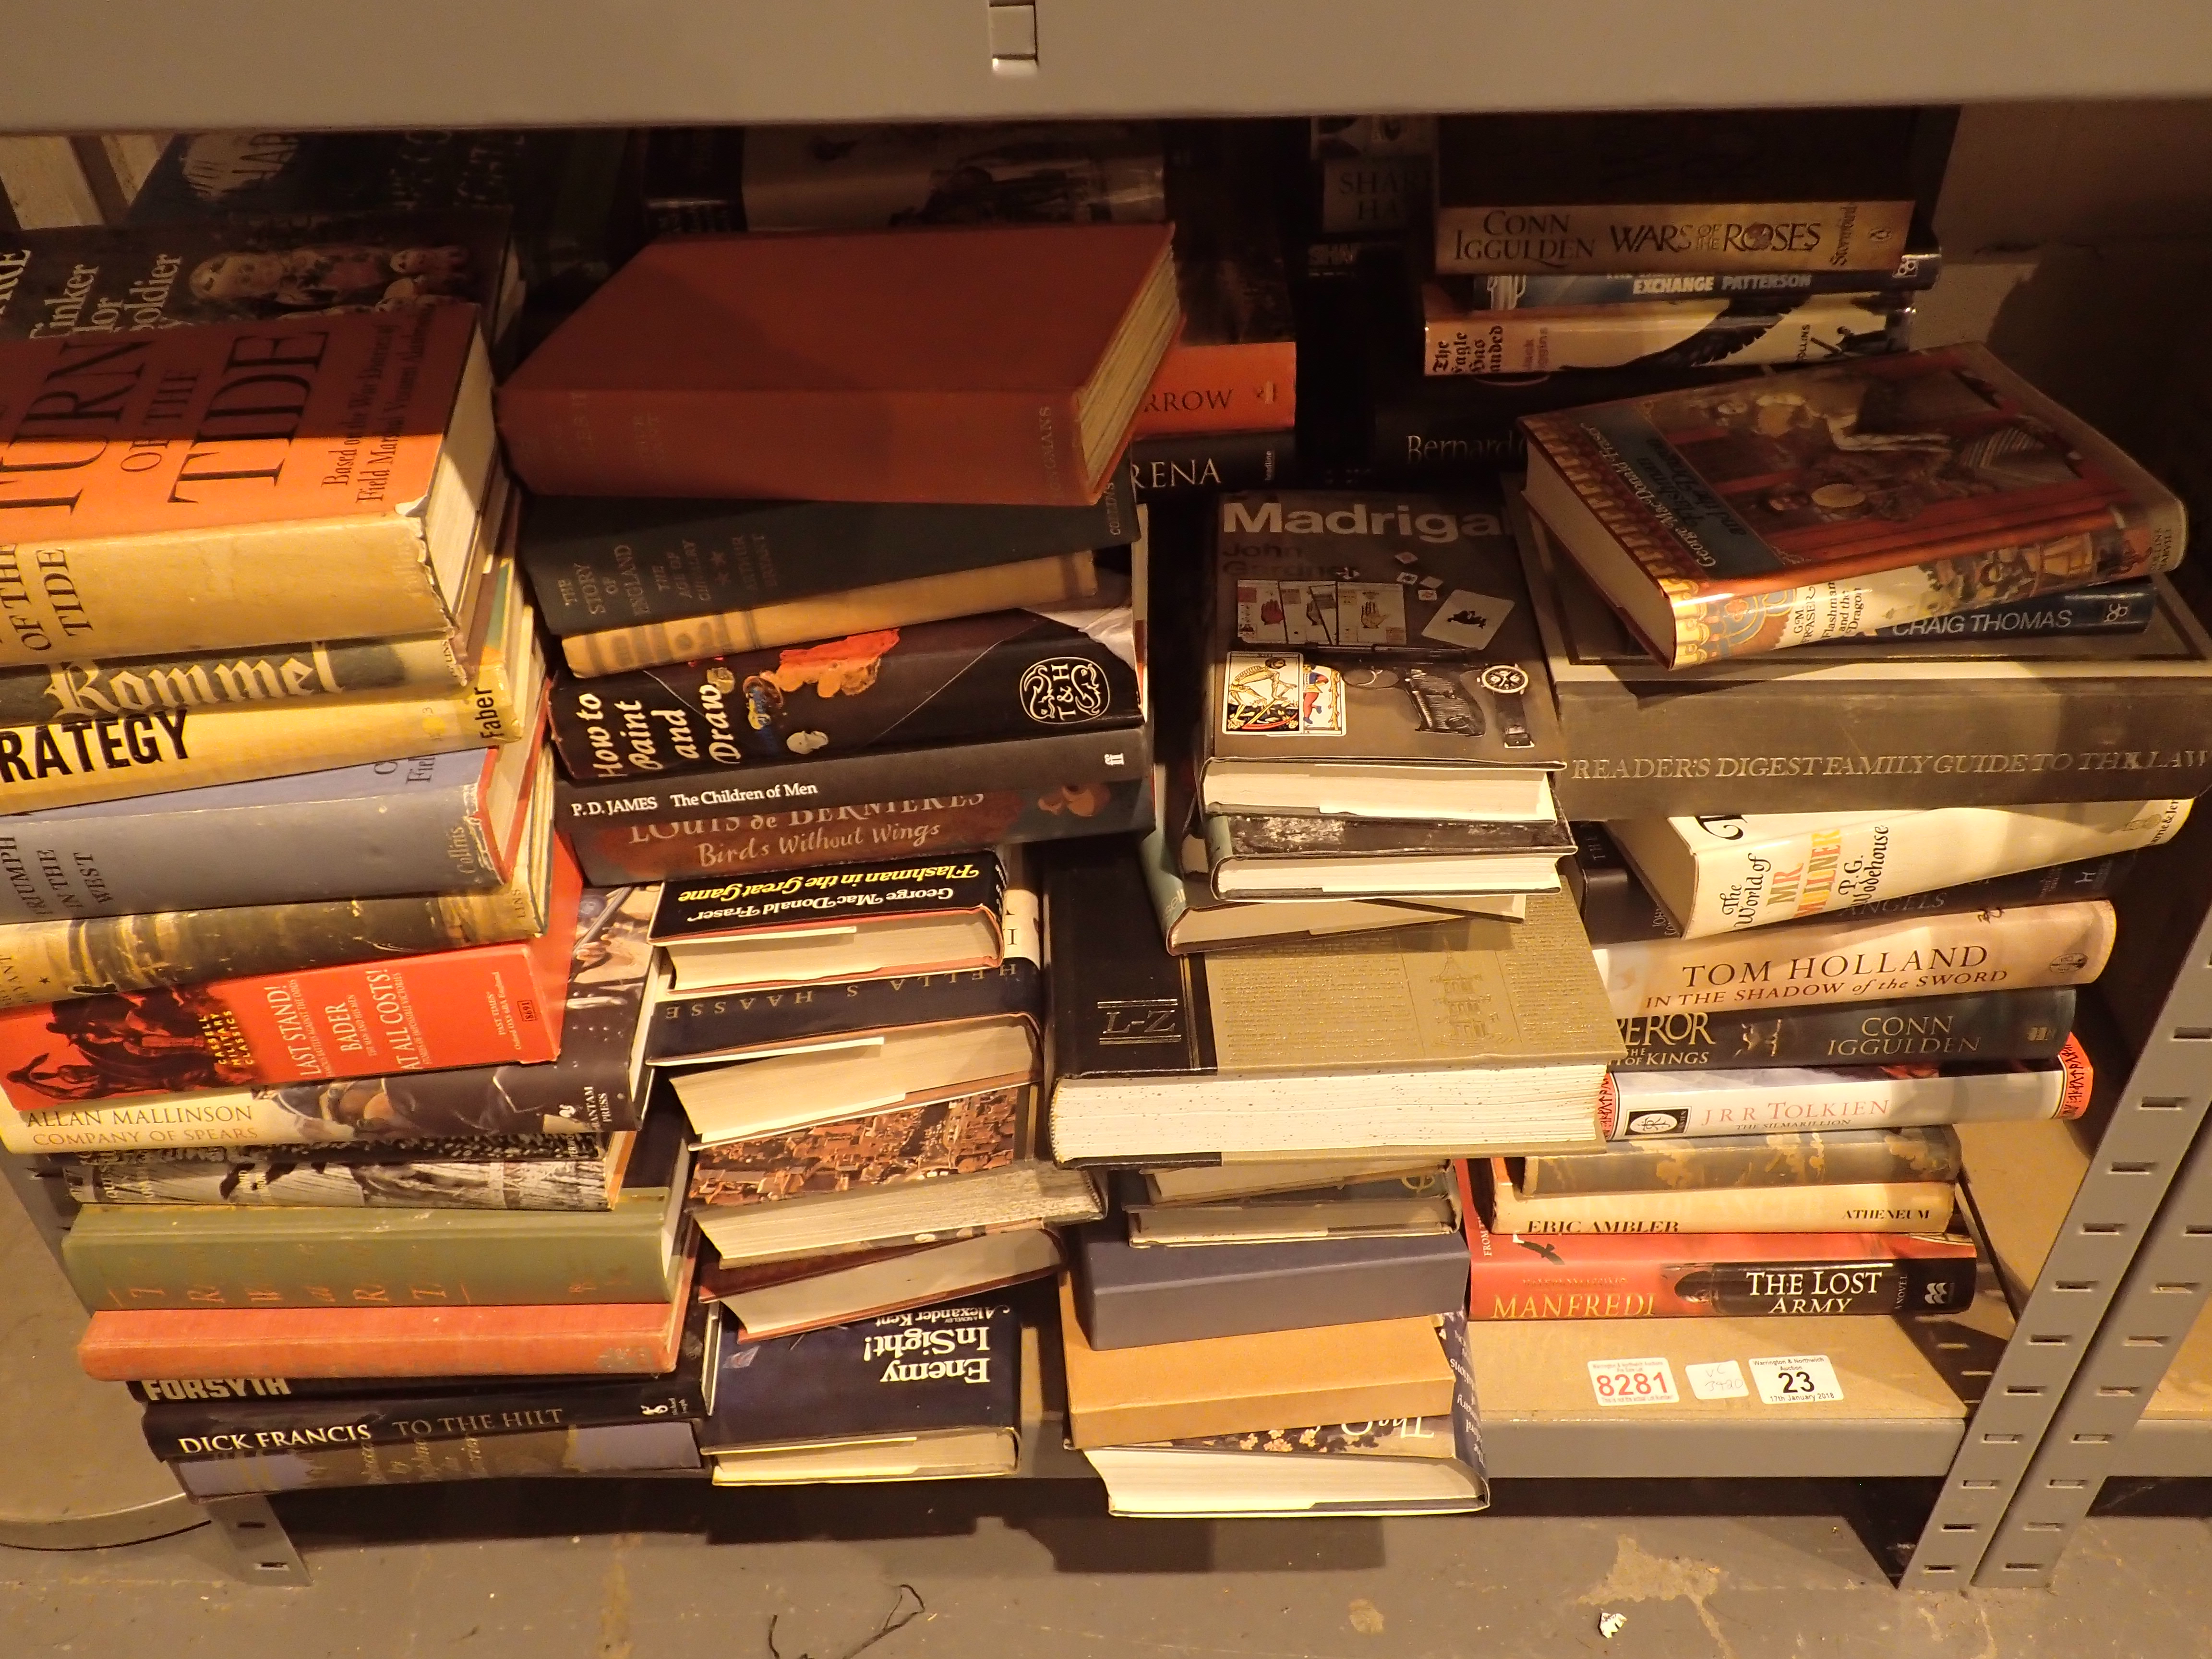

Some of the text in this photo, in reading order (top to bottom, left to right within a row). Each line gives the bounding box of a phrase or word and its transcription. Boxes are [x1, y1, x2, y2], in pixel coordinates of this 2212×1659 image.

[1484, 210, 1570, 236] CONN
[1695, 222, 1821, 252] THE ROSES
[1455, 223, 1722, 268] IGGULDEN WARS OF
[1633, 275, 1812, 295] EXCHANGE PATTERSON
[1432, 341, 1449, 373] The
[0, 337, 153, 515] TURN
[120, 369, 201, 472] OF THE
[167, 330, 328, 505] TIDE
[1406, 430, 1513, 465] Bernard
[321, 449, 357, 486] Based
[355, 469, 390, 502] Field
[1223, 543, 1303, 559] John
[1674, 524, 1717, 573] George
[36, 550, 93, 636] TIDE
[574, 563, 606, 614] STORY
[603, 577, 618, 594] OF
[613, 544, 650, 615] ENGLAND
[652, 565, 672, 591] THE
[1823, 581, 1838, 638] Flashman
[1838, 589, 1850, 635] and the
[1848, 586, 1865, 637] Dragon
[1893, 609, 2072, 635] CRAIG THOMAS
[9, 615, 52, 651] OF
[44, 641, 344, 720] Rommel
[474, 687, 504, 739] Faber
[698, 684, 741, 765] Draw
[0, 708, 189, 783] RATEGY
[577, 694, 628, 778] How to
[651, 709, 701, 759] and
[1571, 749, 2208, 781] READER'S DIGEST FAMILY GUIDE TO THE LAW
[670, 782, 817, 809] The Children of Men
[750, 813, 776, 830] de
[445, 826, 476, 874] Collins
[698, 823, 941, 867] Birds Without Wings
[36, 850, 70, 891] THE
[73, 852, 114, 904] WEST
[678, 863, 980, 903] Flashman in the Great Game
[1851, 825, 1889, 908] Wodehouse
[1719, 884, 1741, 917] The
[1733, 853, 1772, 929] World of
[1767, 862, 1803, 907] MR
[686, 887, 955, 923] George Fraser
[1683, 945, 1989, 988] TOM HOLLAND
[666, 990, 813, 1020] HAASSE
[846, 984, 859, 997] S
[1646, 969, 2008, 1009] IN THE SHADOW of the SWORD
[265, 986, 323, 1077] LAST STAND!
[324, 1002, 363, 1053] BADER
[365, 969, 421, 1069] AT ALL COSTS!
[1103, 1010, 1175, 1034] L-Z
[1861, 1015, 1953, 1037] CONN
[199, 1015, 225, 1065] CASSELL
[210, 1013, 241, 1068] MILITARY
[223, 1010, 253, 1065] CLASSICS
[1828, 1036, 1980, 1057] IGGULDEN
[1645, 1050, 1709, 1065] KINGS
[27, 1106, 252, 1127] ALLAN MALLINSON
[599, 1093, 613, 1123] PRESS
[1718, 1106, 1736, 1124] R
[1739, 1104, 1757, 1122] R
[1767, 1099, 1890, 1119] TOLKIEN
[1763, 1119, 1851, 1130] SILMARILLION
[33, 1127, 258, 1146] COMPANY OF SPEARS
[1528, 1220, 1679, 1233] ERIC AMBLER
[1842, 1208, 1929, 1220] ATHENEUM
[1482, 1225, 1492, 1257] FROM
[1746, 1270, 1882, 1295] THE LOST
[1896, 1274, 1907, 1302] NOVEL
[875, 1304, 1010, 1328] Kent Alexander
[1491, 1293, 1853, 1319] MANFREDI ARMY
[880, 1358, 990, 1383] Enemy
[1753, 1358, 1785, 1367] Warrington
[143, 1378, 292, 1401] FORSYTH
[1596, 1372, 1669, 1396] 8281
[1778, 1372, 1815, 1393] 23
[1787, 1394, 1815, 1402] January
[178, 1408, 563, 1454] DICK FRANCIS TO THE HILT
